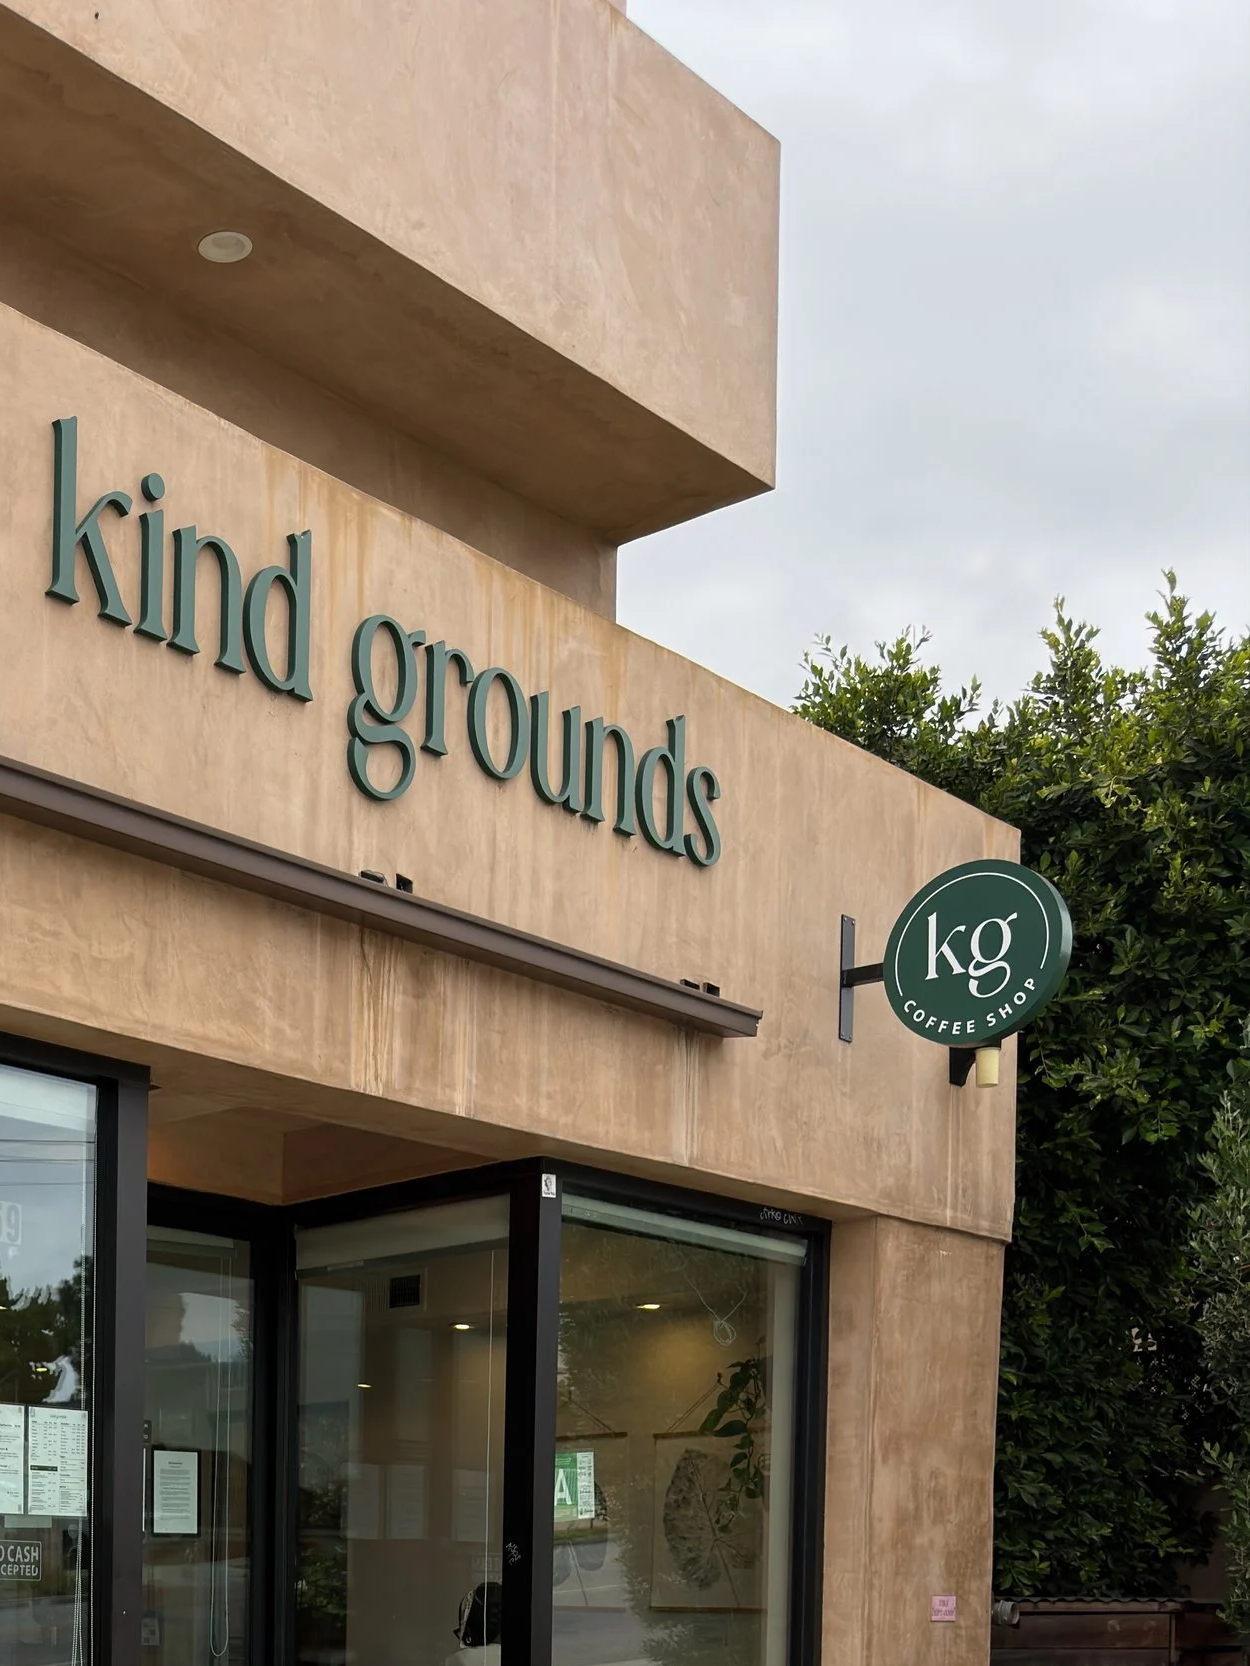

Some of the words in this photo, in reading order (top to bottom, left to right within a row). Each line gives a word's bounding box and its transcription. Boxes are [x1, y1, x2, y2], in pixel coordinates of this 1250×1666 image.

[45, 415, 312, 702] kind
[347, 614, 722, 867] grounds
[925, 911, 1018, 998] kg
[903, 999, 976, 1035] COFFEE
[986, 977, 1036, 1027] SHOP
[554, 1468, 572, 1507] A
[7, 1545, 39, 1563] CASH
